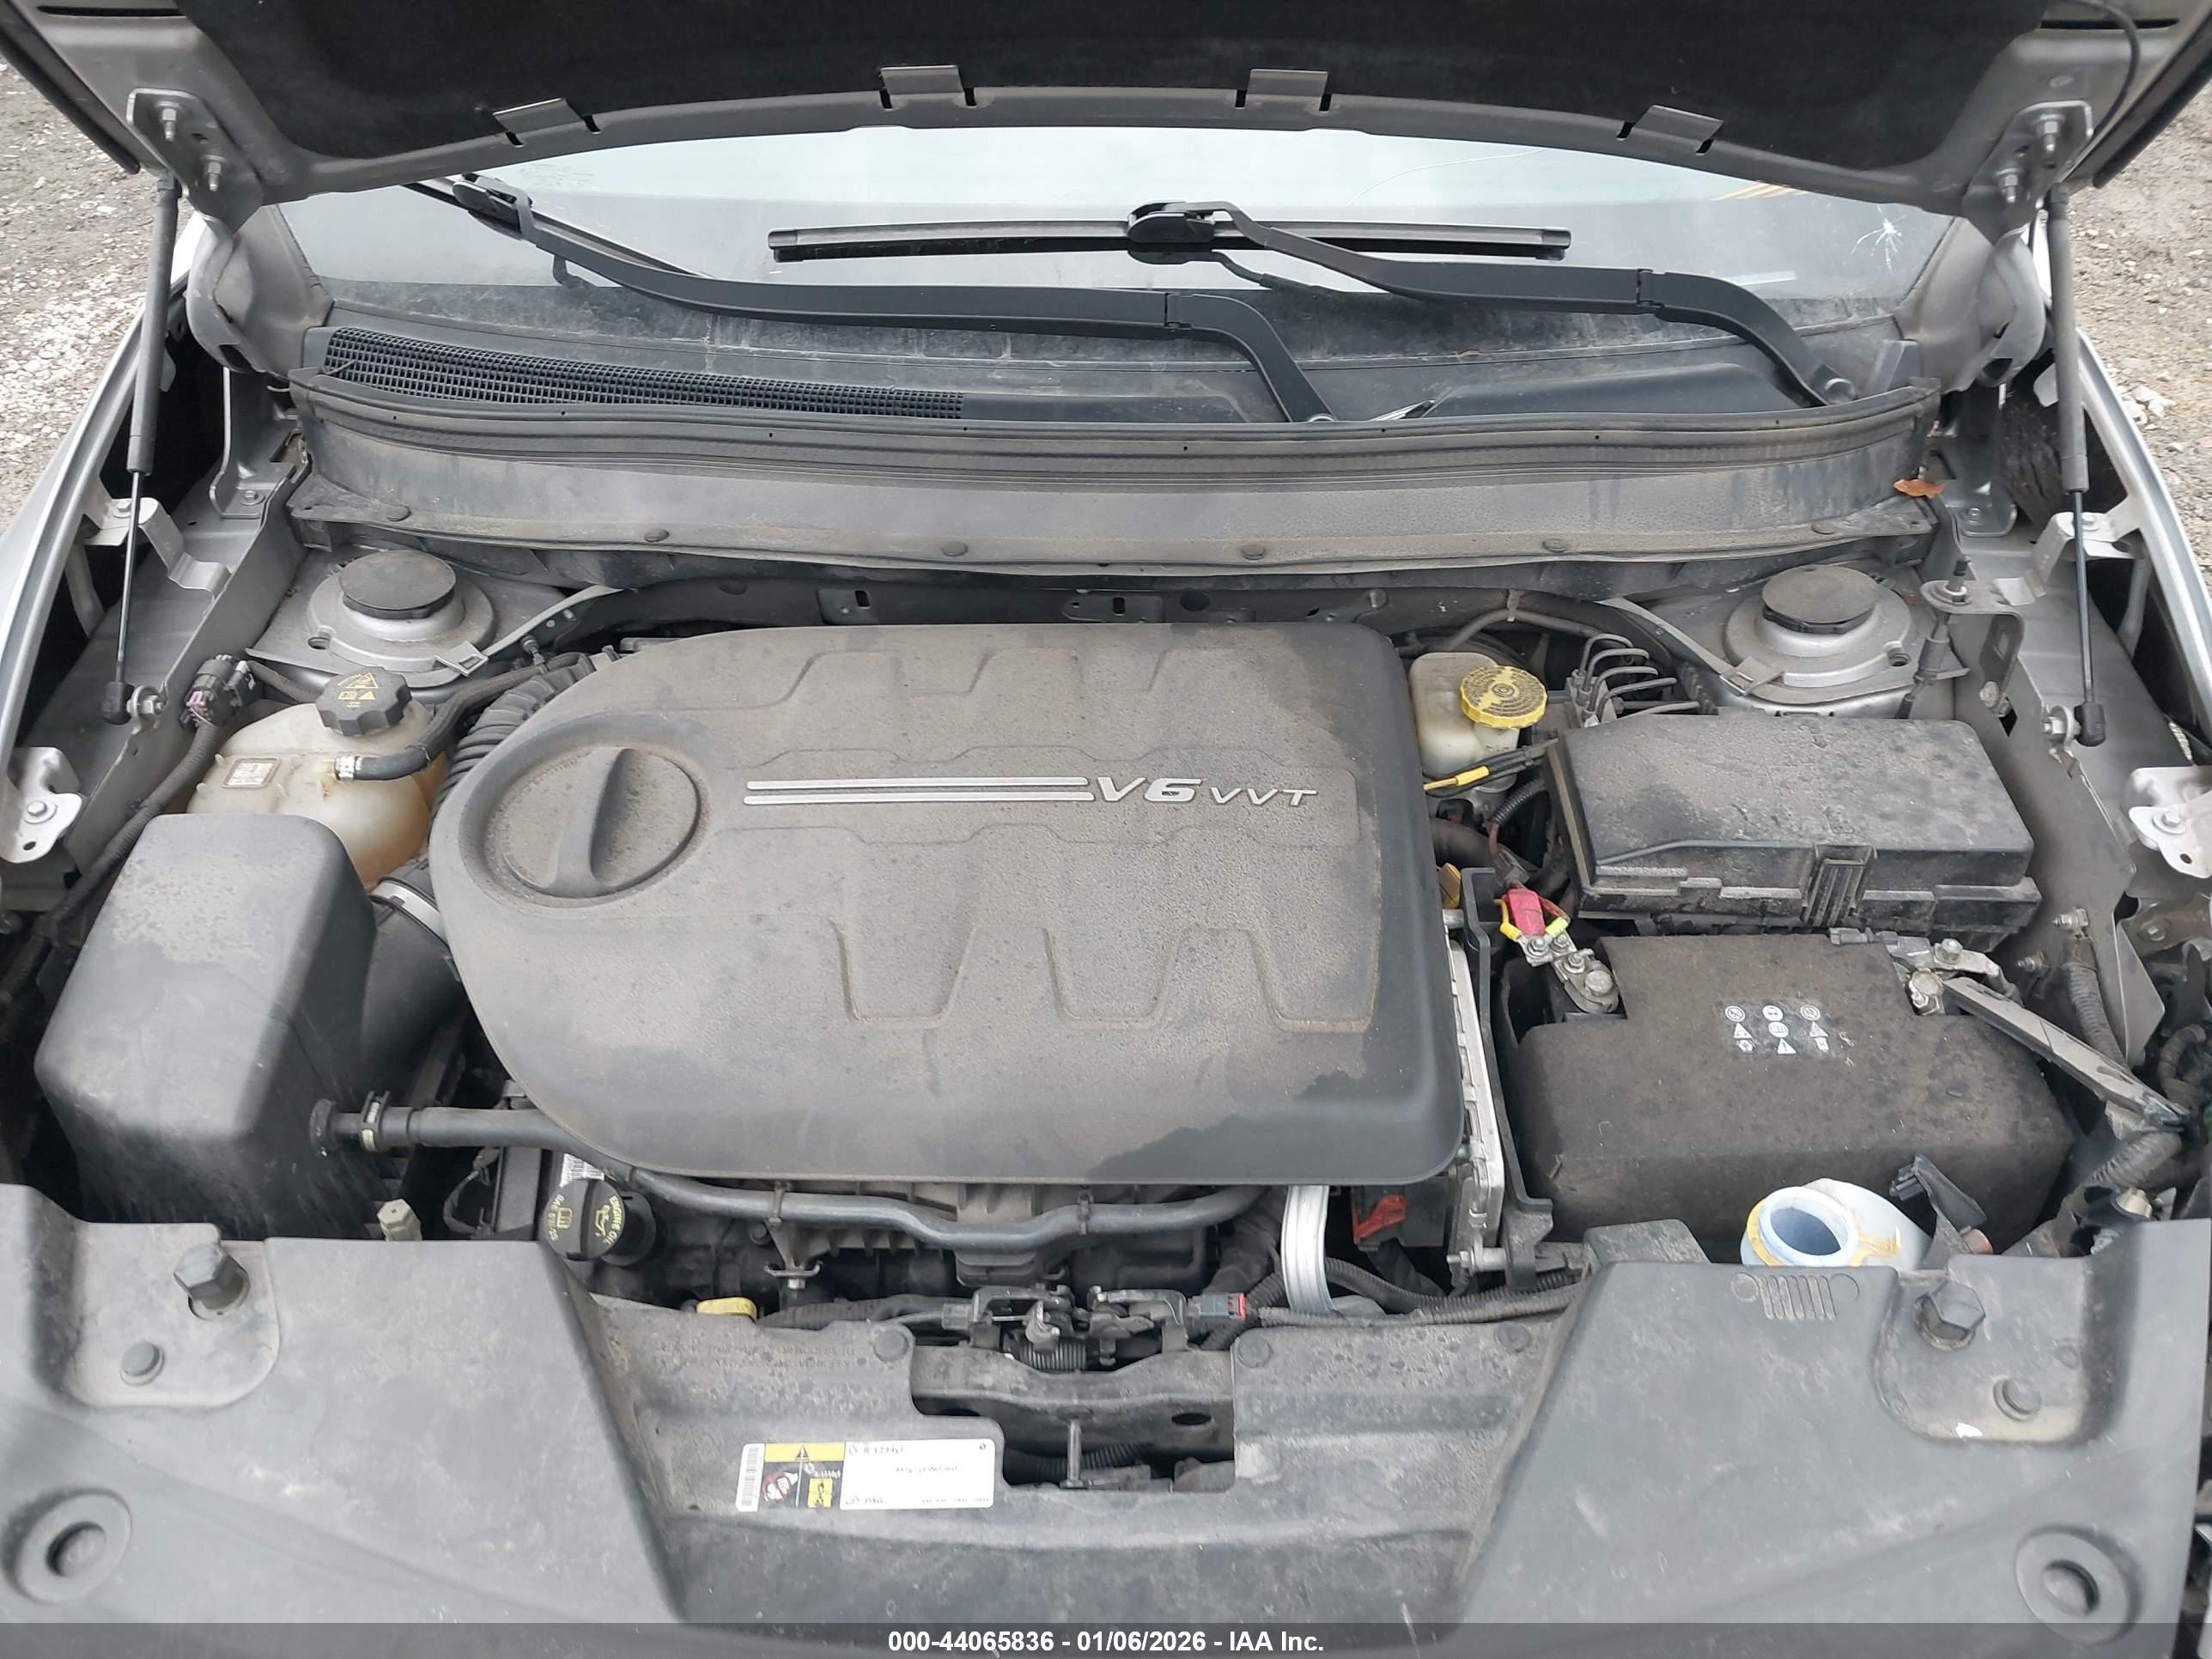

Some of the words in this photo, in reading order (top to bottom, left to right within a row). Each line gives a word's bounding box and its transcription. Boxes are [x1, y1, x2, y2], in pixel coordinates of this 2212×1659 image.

[1097, 776, 1202, 803] V6
[1210, 787, 1318, 807] VVT
[609, 1195, 623, 1231] ENGINE
[603, 1230, 618, 1246] OIL
